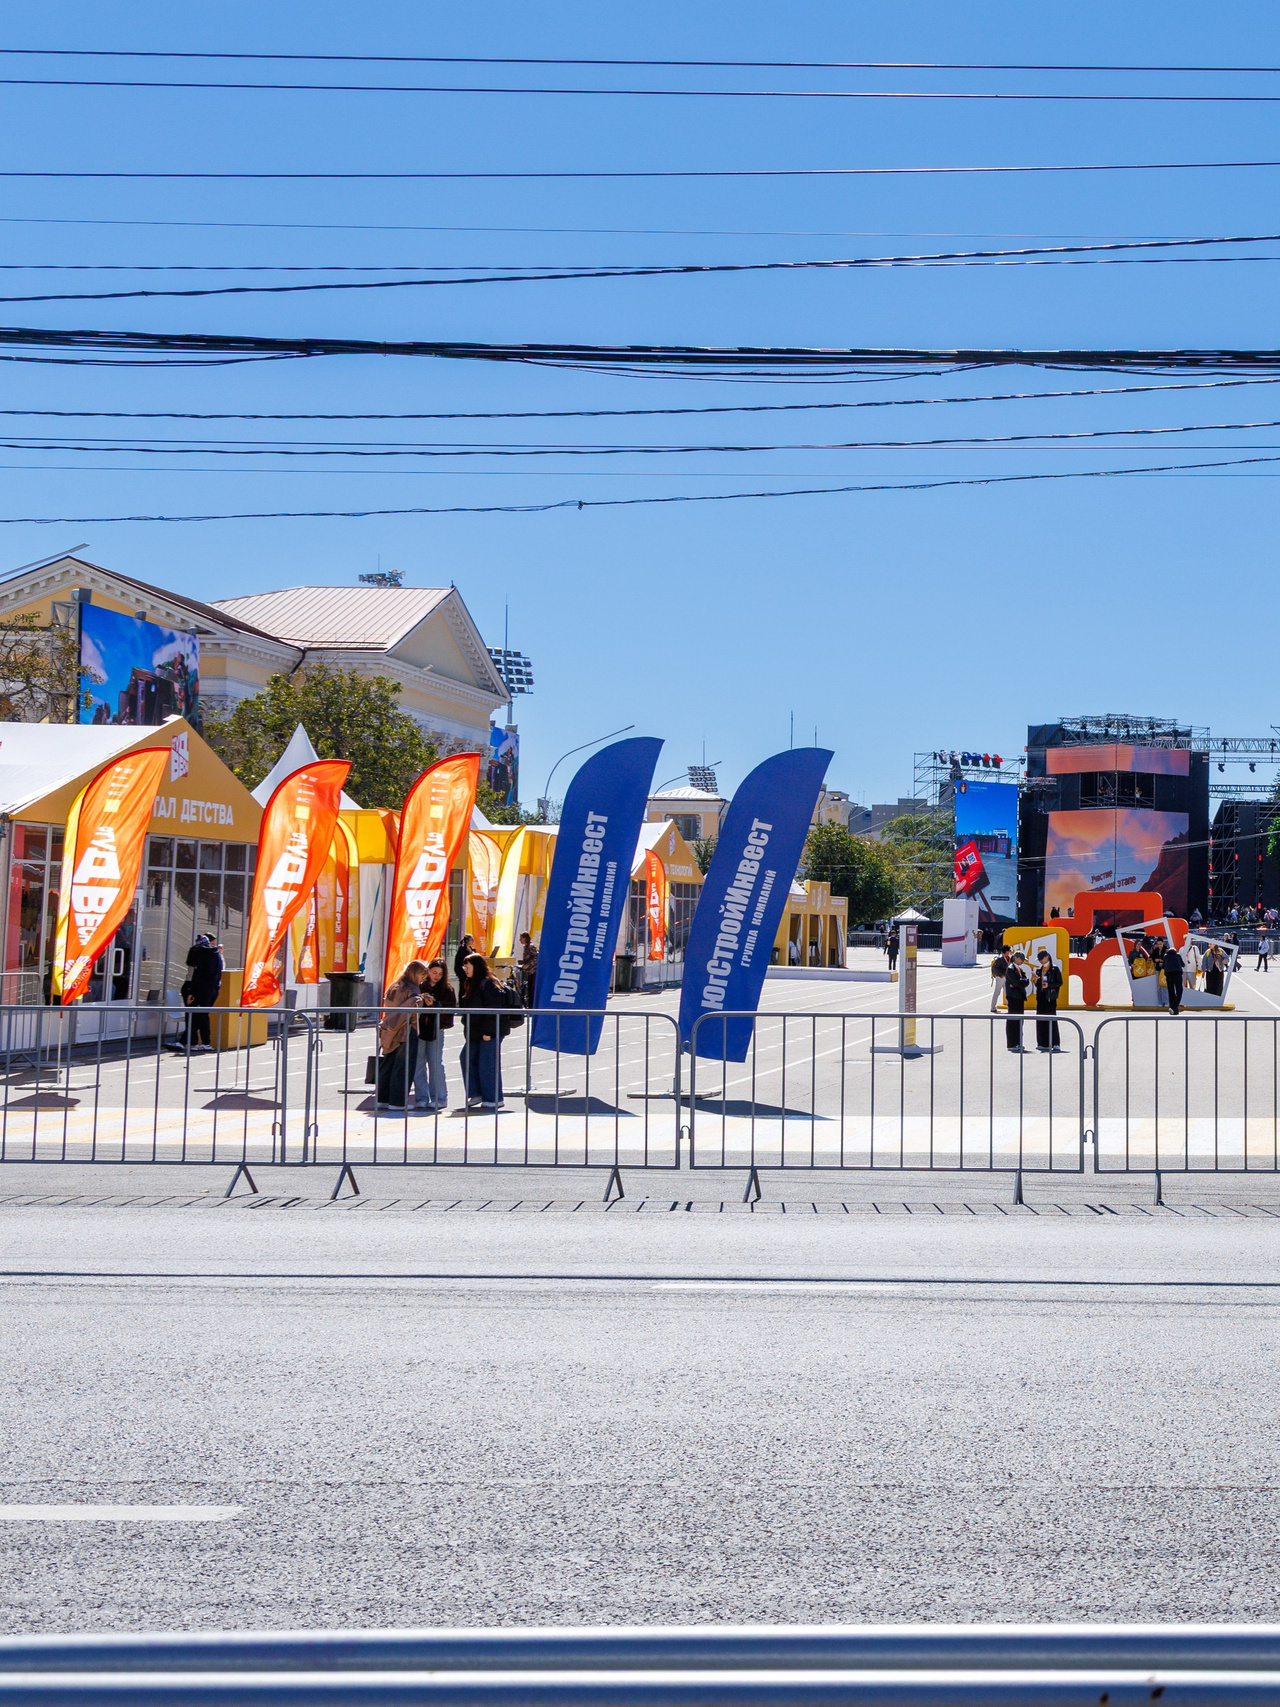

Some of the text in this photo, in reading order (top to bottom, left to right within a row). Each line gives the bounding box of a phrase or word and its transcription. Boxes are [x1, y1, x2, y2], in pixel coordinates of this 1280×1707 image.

[180, 798, 235, 826] ДЕТСТВА
[407, 832, 447, 889] СТУД
[550, 810, 609, 1005] ЮгСтройИнвест
[592, 860, 618, 960] ГРУППА КОМПАНИЙ
[700, 817, 773, 1010] ЮгСтройИнвест
[740, 870, 777, 968] ГРУППА КОМПАНИЙ
[1117, 876, 1137, 888] этапе
